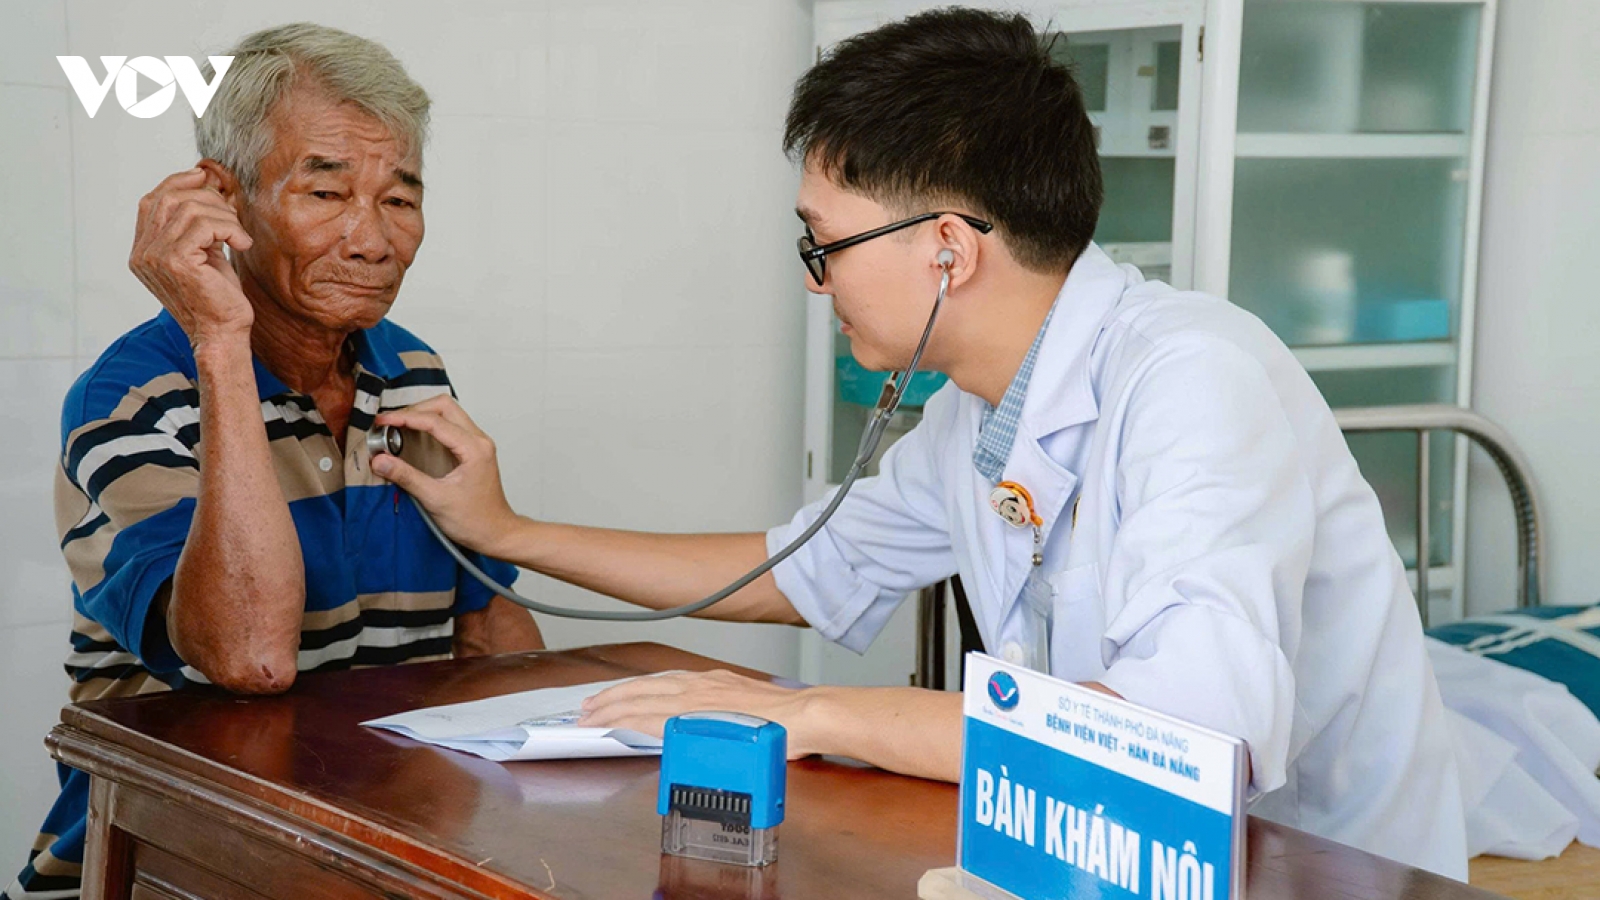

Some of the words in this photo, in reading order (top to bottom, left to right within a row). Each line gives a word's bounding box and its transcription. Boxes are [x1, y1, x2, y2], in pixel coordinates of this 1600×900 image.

[1046, 713, 1071, 734] BỆNH
[1074, 723, 1096, 744] VIỆN
[1098, 731, 1118, 753] VIỆT
[1128, 742, 1149, 763] HÀN
[976, 764, 1036, 847] BÀN
[1045, 796, 1140, 894] KHÁM
